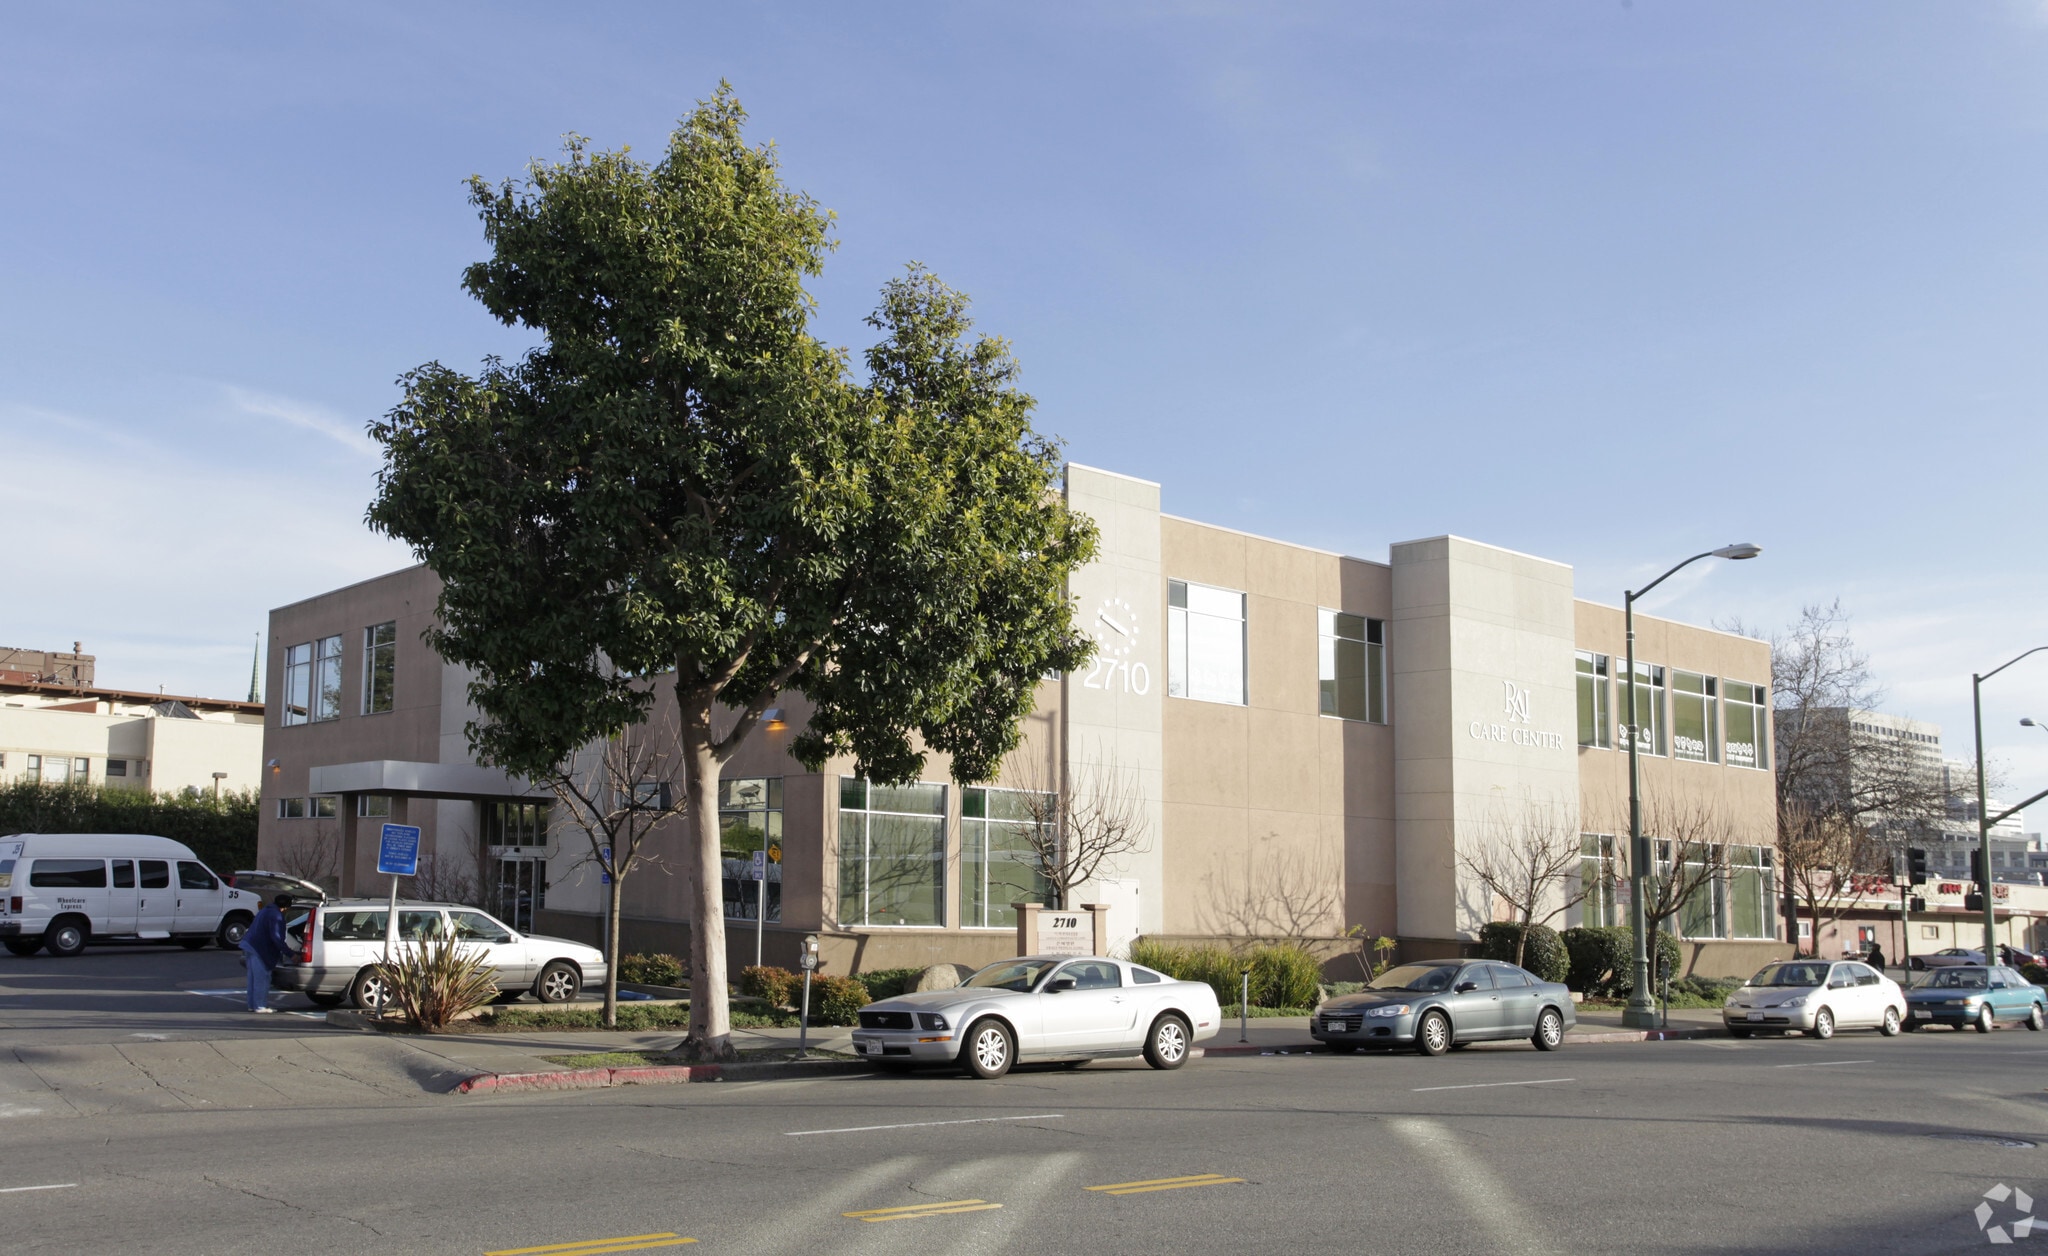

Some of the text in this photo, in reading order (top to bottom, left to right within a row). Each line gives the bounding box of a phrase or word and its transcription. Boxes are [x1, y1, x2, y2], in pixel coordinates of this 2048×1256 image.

[1083, 656, 1150, 696] 2710
[1469, 721, 1564, 750] CARE CENTER
[228, 890, 239, 899] 35
[1053, 917, 1077, 928] 2710
